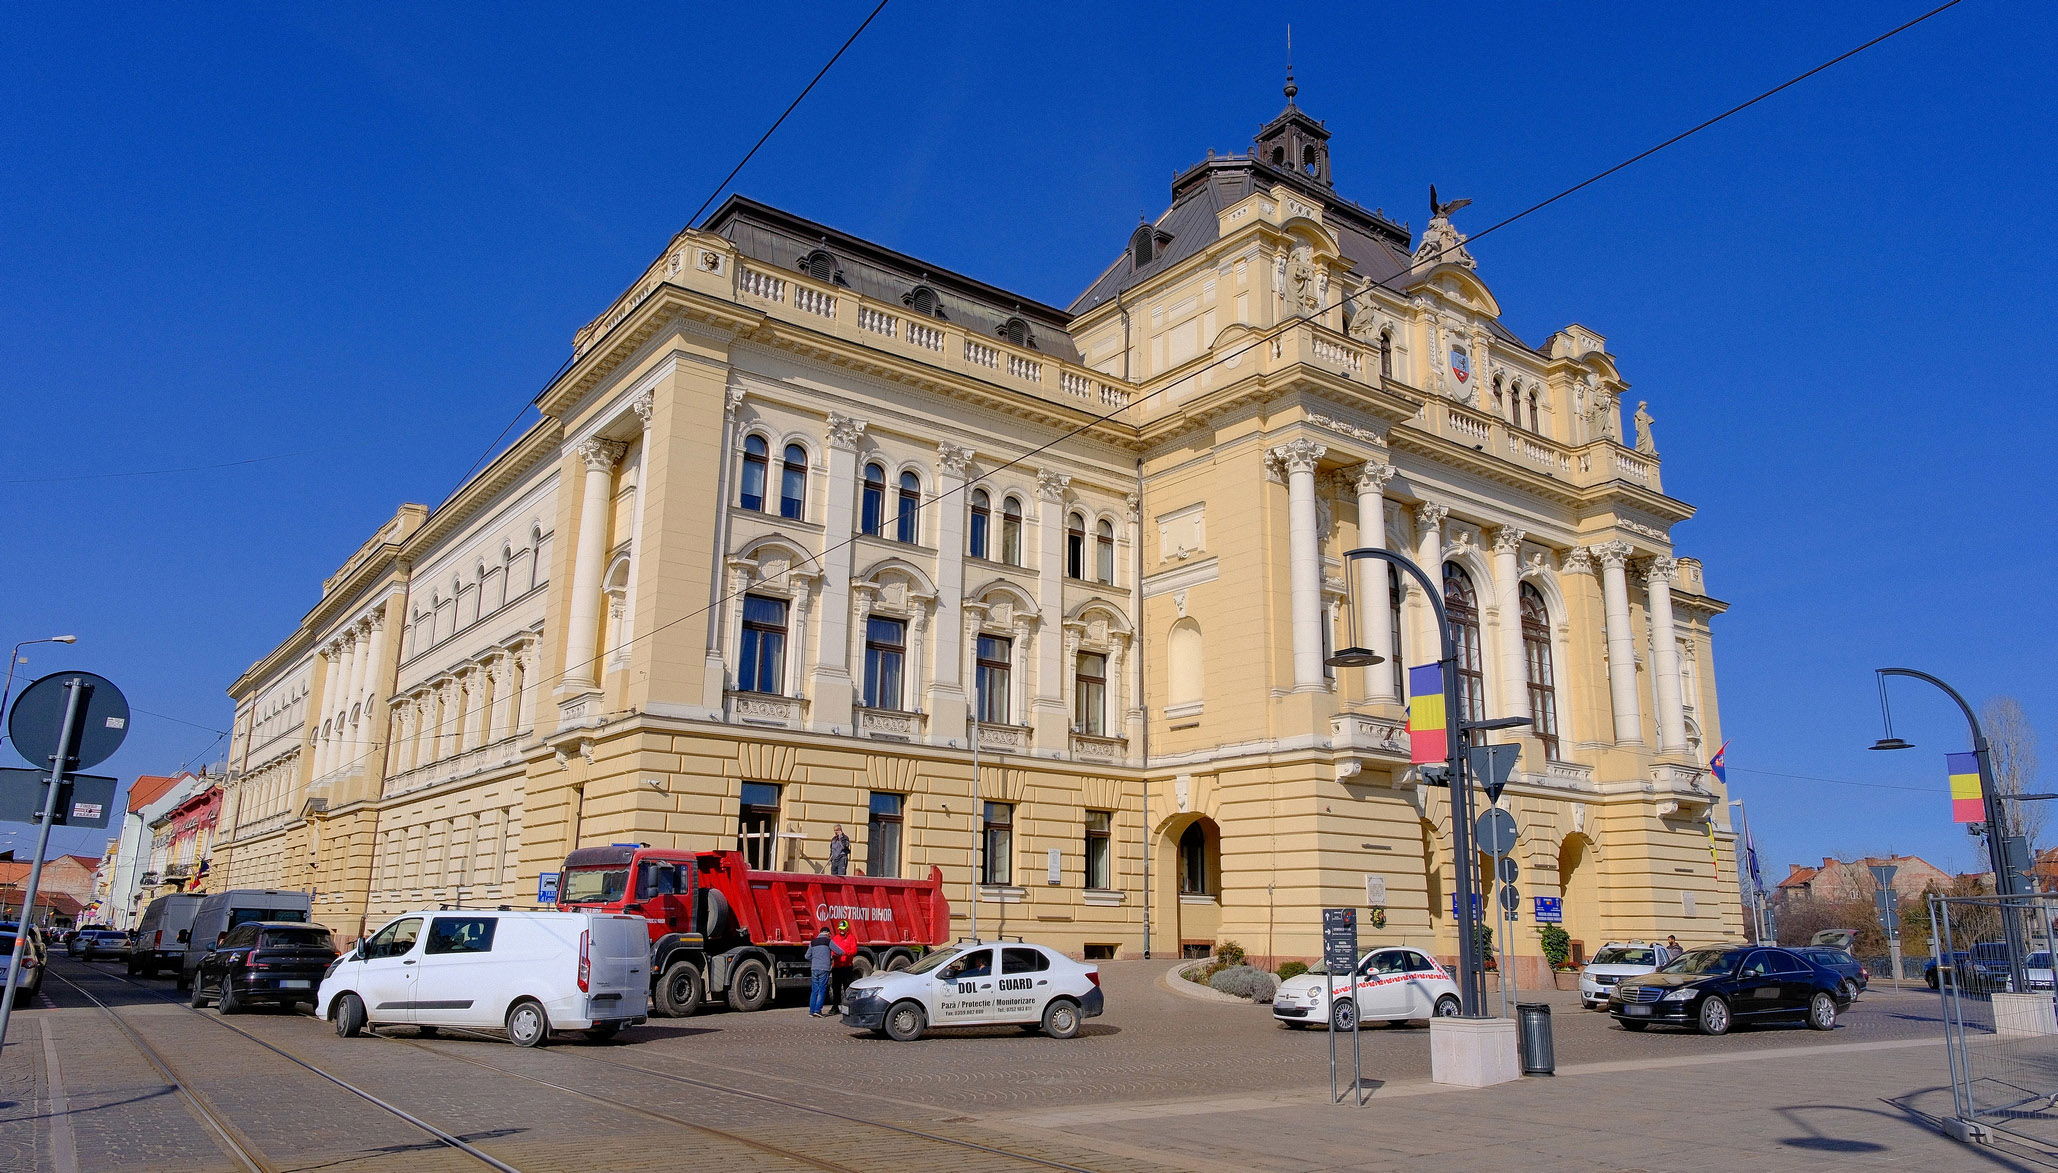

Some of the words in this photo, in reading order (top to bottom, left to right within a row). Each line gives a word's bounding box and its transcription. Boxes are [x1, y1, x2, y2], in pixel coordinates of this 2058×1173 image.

[871, 908, 893, 922] BIHOR
[958, 981, 978, 995] DOL
[998, 978, 1033, 991] GUARD
[996, 997, 1036, 1006] Monitorizare
